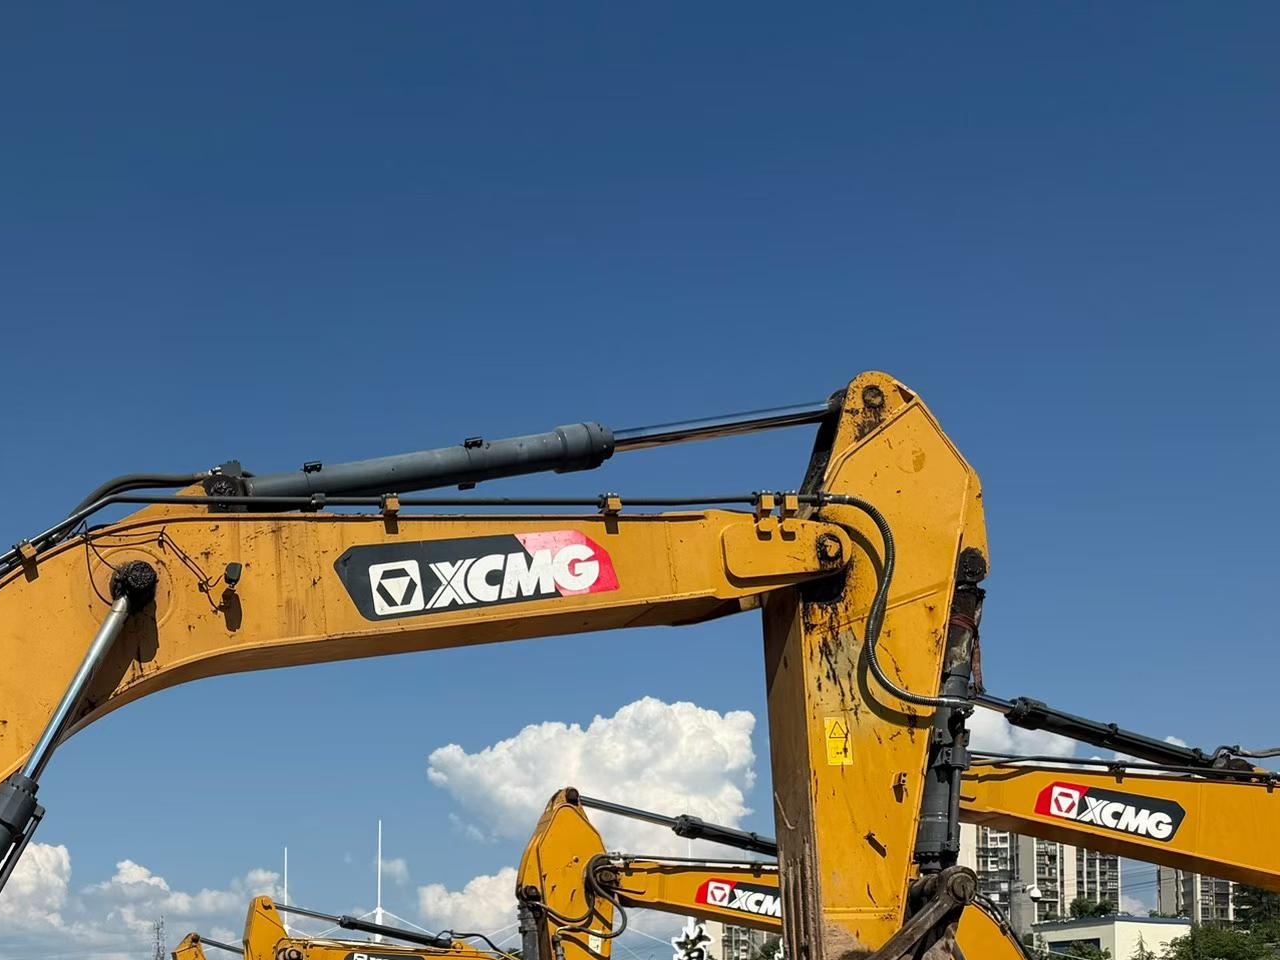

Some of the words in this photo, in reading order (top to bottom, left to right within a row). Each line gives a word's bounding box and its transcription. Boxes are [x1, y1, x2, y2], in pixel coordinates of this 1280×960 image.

[425, 543, 600, 610] XCMG
[1077, 796, 1173, 839] XCMG
[728, 888, 782, 918] XCM
